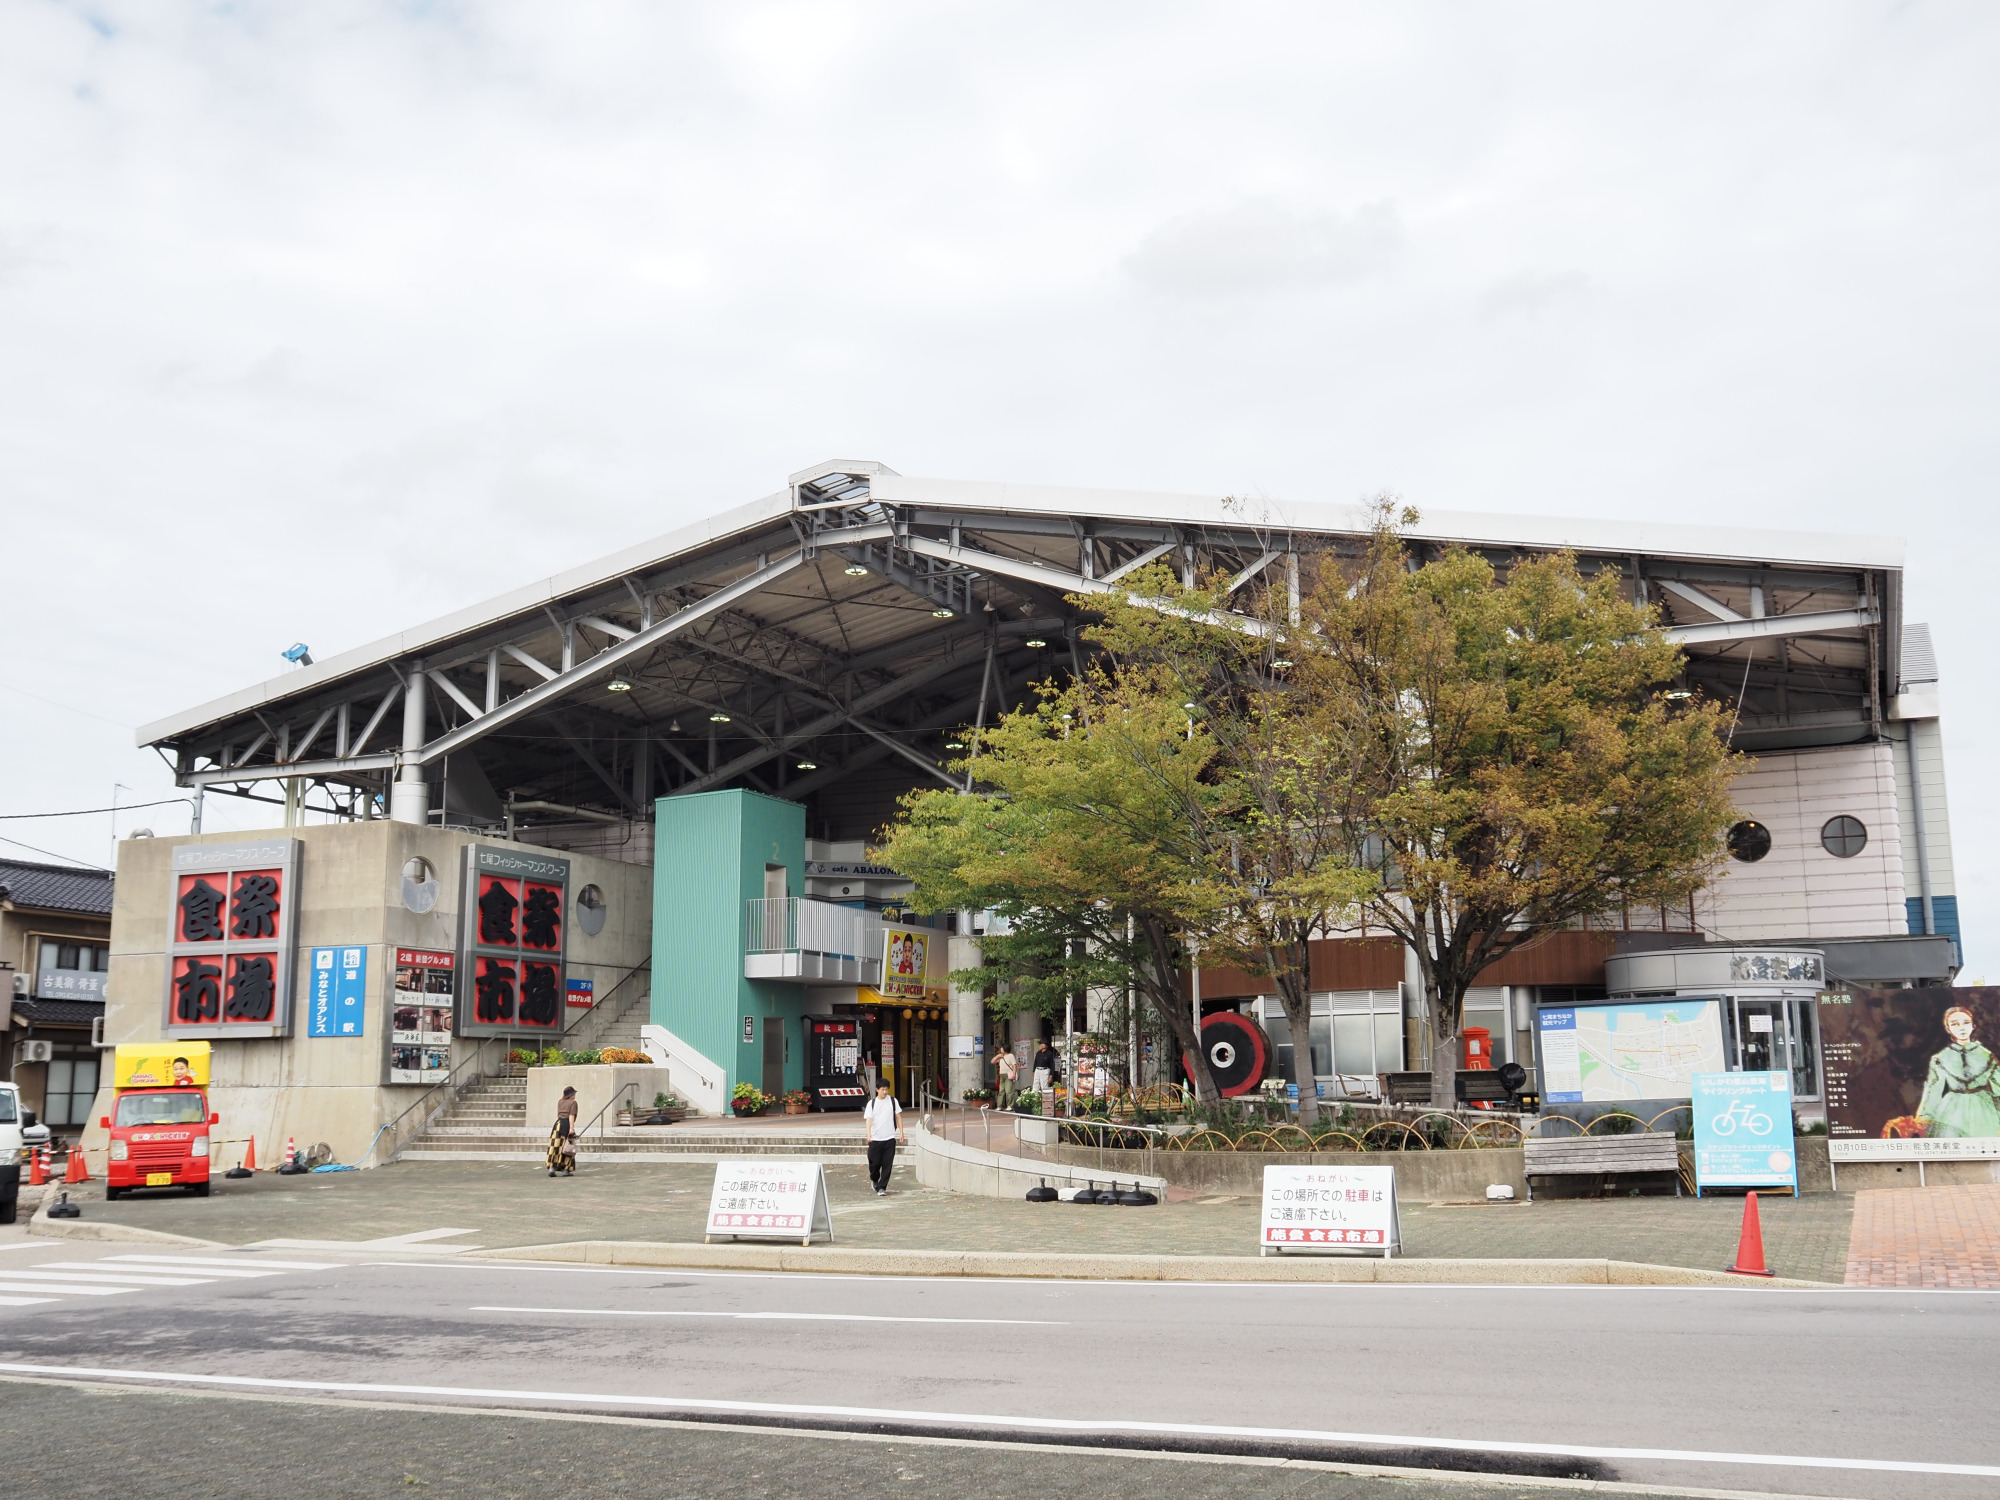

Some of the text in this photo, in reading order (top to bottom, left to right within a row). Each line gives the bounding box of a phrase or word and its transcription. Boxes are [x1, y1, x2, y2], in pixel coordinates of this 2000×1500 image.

[315, 970, 329, 1033] みなとオアシス
[342, 969, 357, 1033] 道の駅
[1821, 994, 1852, 1005] 無名塾
[1306, 1174, 1348, 1183] おねがい
[721, 1181, 807, 1193] この場所での駐車は
[1271, 1188, 1383, 1202] この場所での駐車は
